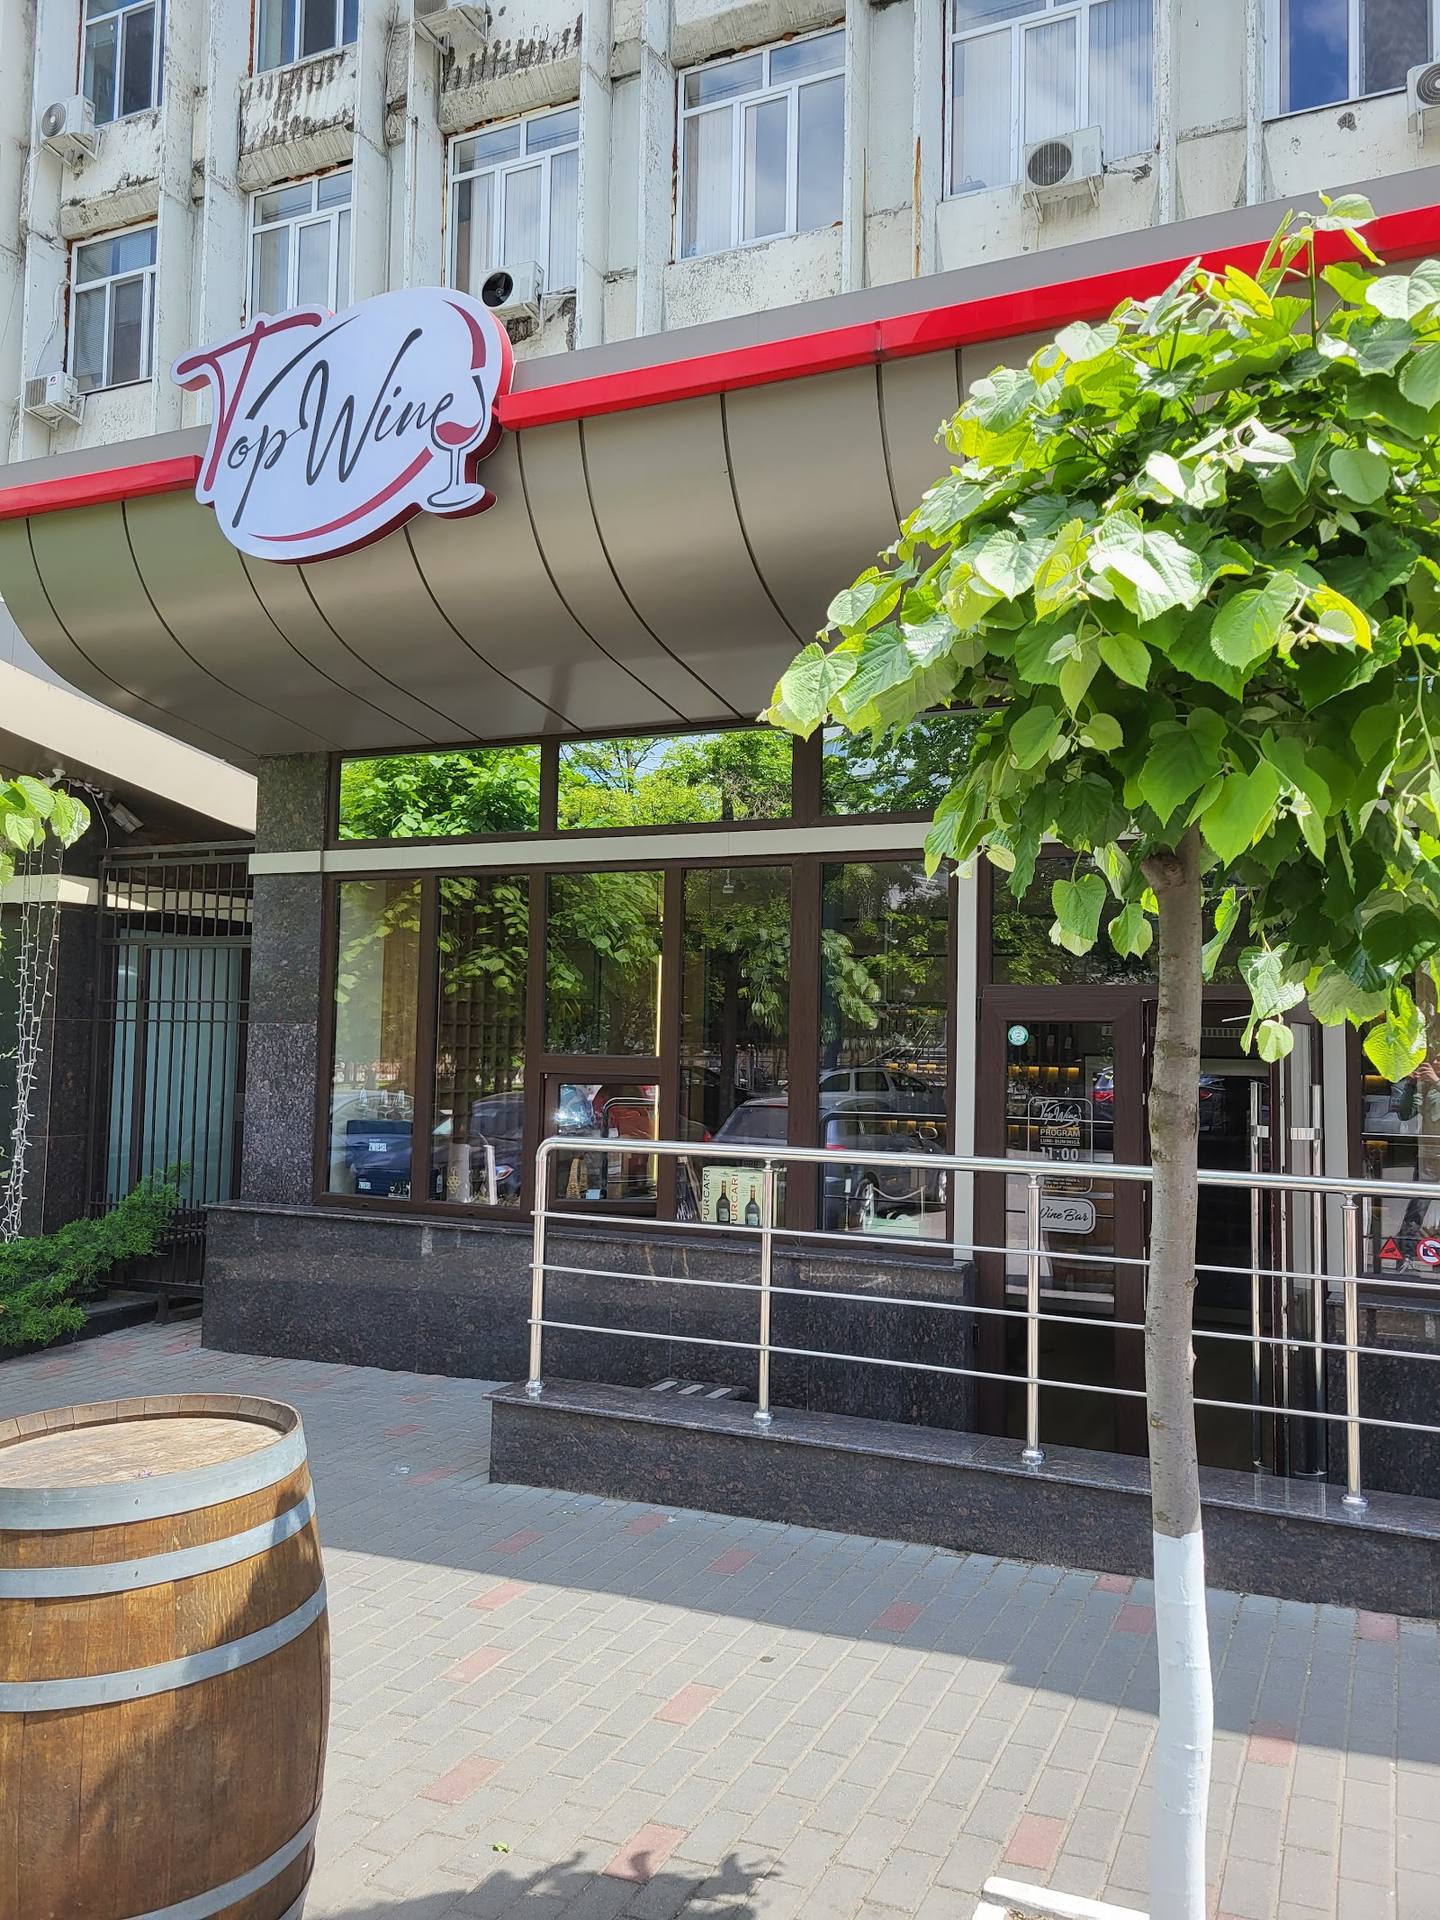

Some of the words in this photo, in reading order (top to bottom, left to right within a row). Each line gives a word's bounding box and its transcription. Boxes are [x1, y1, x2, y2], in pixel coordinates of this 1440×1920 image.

[176, 312, 322, 528] Top
[298, 328, 456, 487] Wine
[1040, 1128, 1080, 1137] PROGRAM
[1040, 1146, 1079, 1161] 11:00
[731, 1174, 739, 1224] URCARI
[1064, 1208, 1088, 1221] Bar
